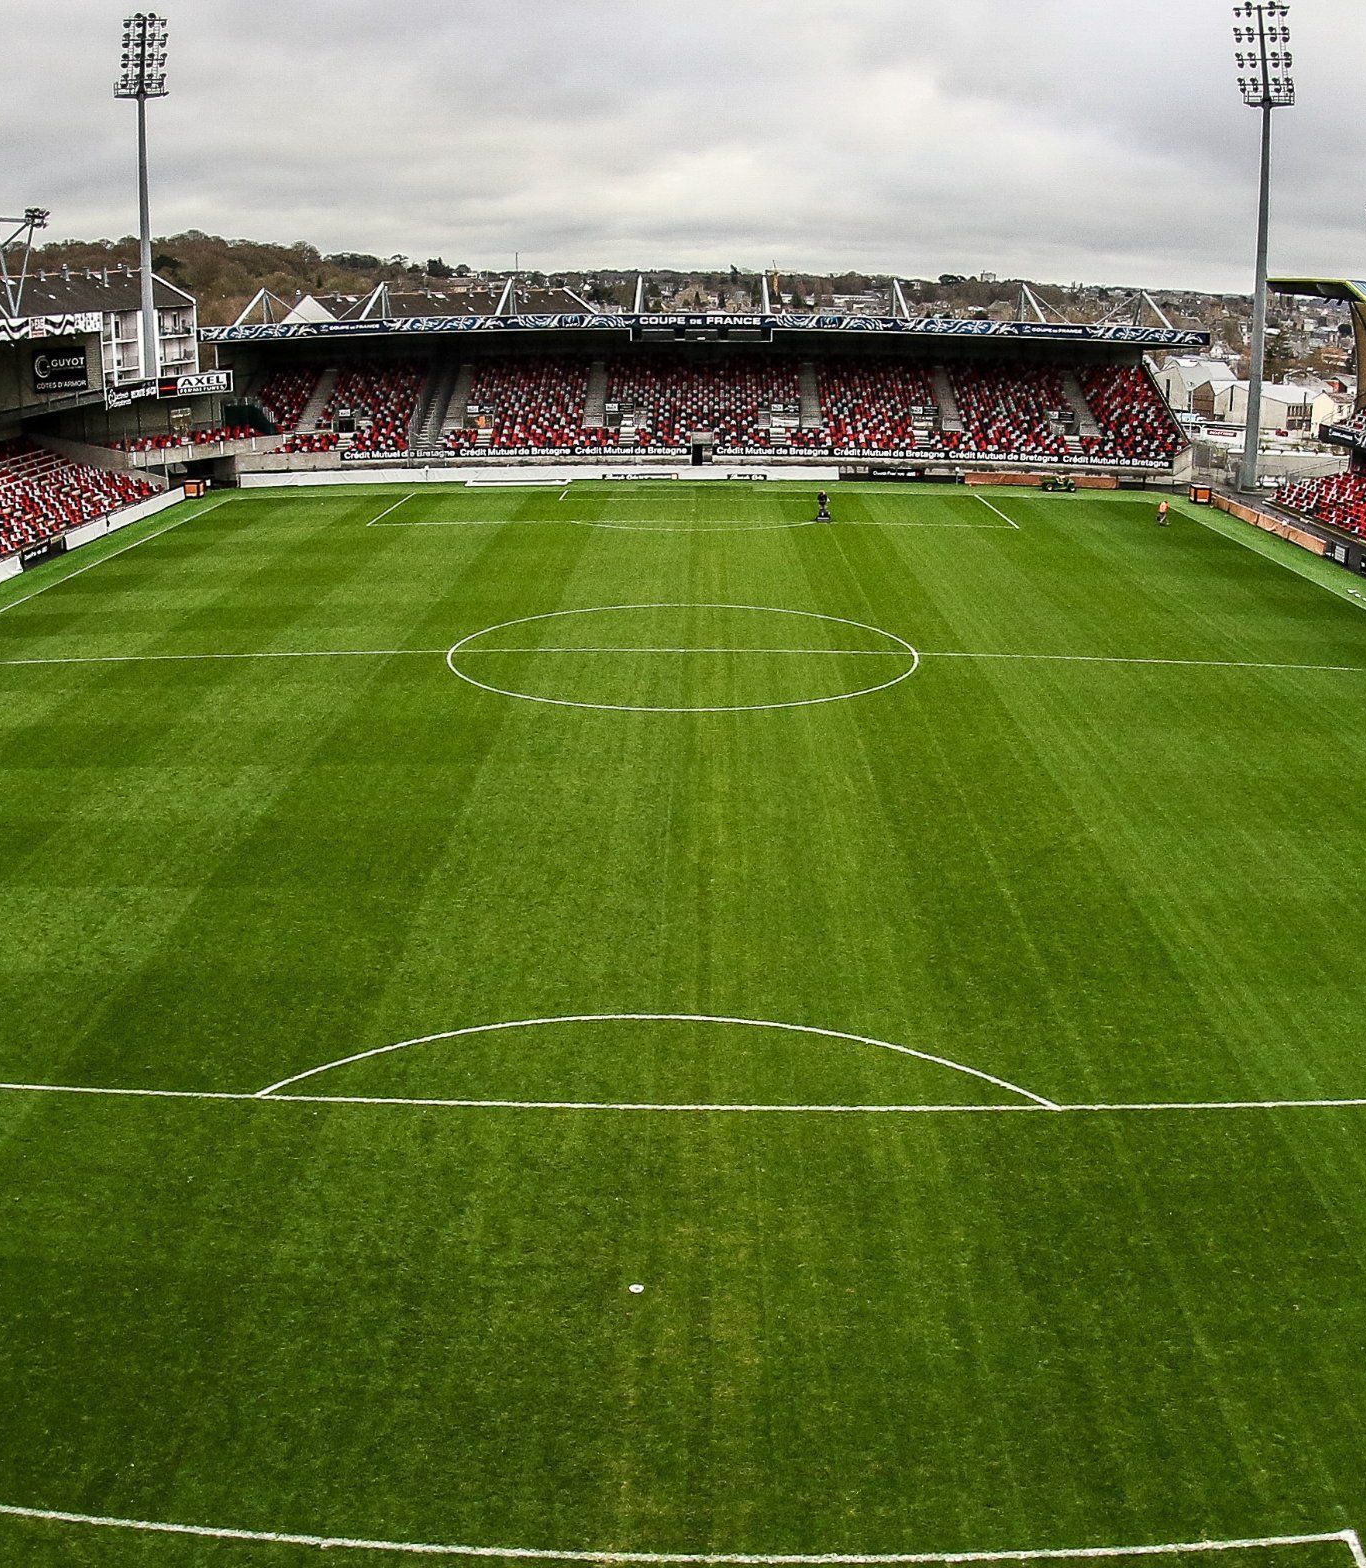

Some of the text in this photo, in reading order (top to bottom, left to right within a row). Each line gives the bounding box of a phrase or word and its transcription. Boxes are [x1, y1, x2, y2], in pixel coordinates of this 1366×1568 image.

[639, 316, 686, 324] COUPE
[706, 316, 762, 325] FRANCE
[51, 356, 84, 367] GUYOT
[181, 375, 225, 387] AXEL
[460, 446, 570, 457] Crédit Mutuel de Bretagne
[575, 446, 687, 456] Crédit Mutuel de Bretagne
[717, 446, 828, 456] Crédit Mutuel de Bretagne
[834, 447, 945, 460] Crédit Mutuel de Bretagne
[949, 450, 1058, 463] Crédit Mutuel de Bretagne
[1063, 455, 1169, 468] Crédit Mutuel de Bretagne
